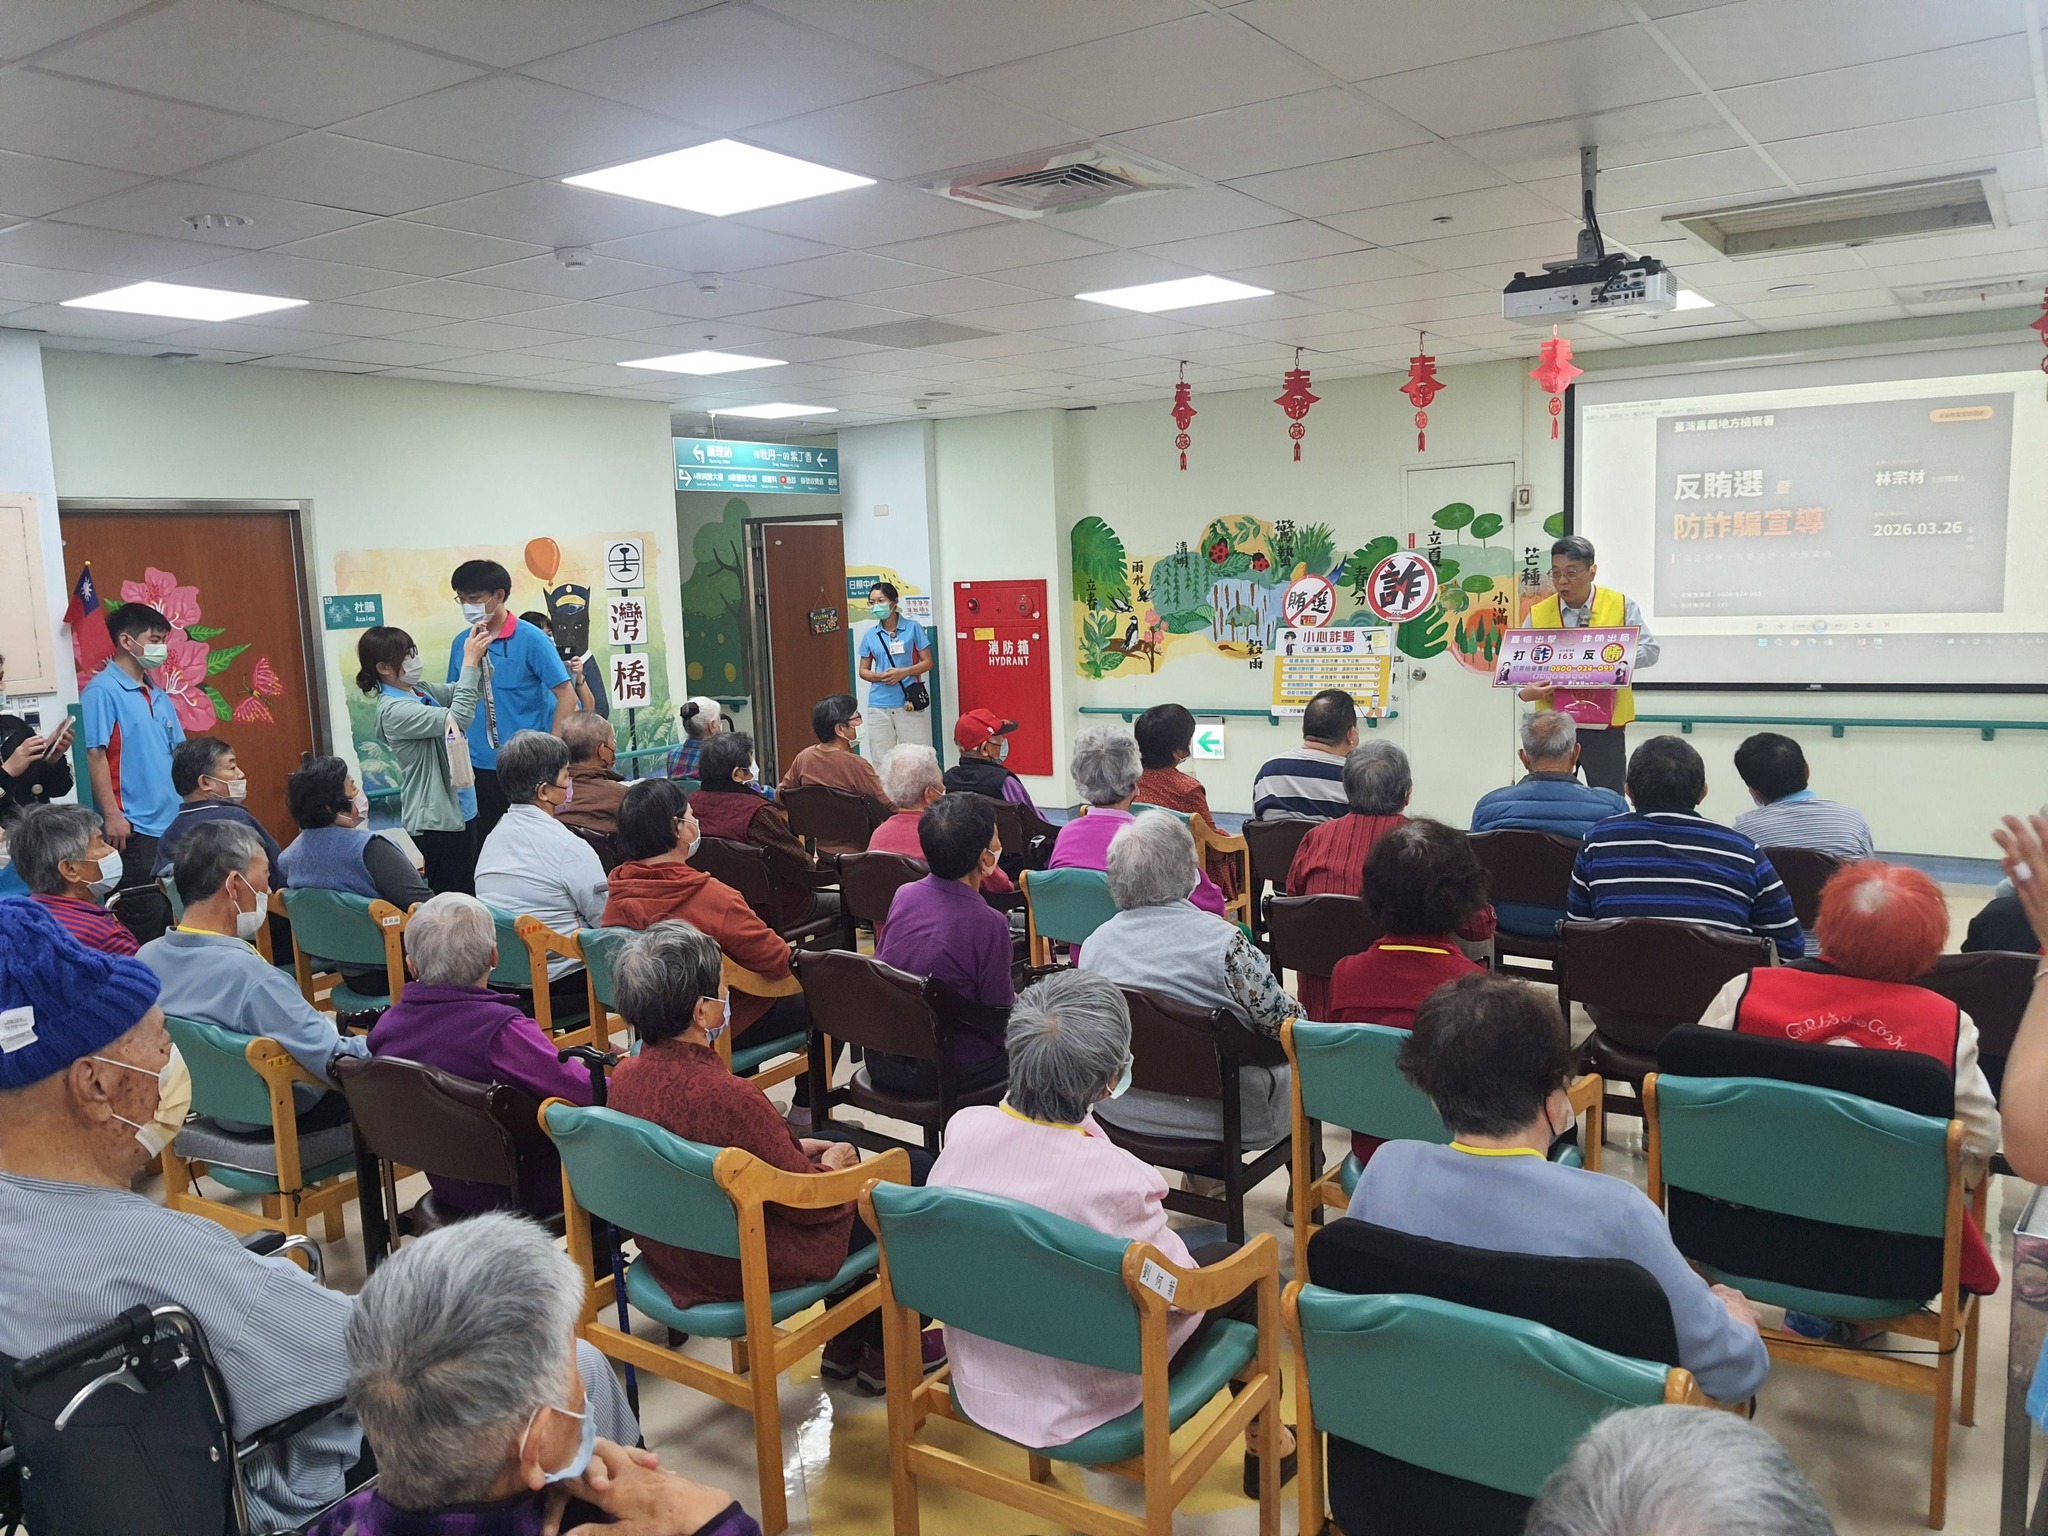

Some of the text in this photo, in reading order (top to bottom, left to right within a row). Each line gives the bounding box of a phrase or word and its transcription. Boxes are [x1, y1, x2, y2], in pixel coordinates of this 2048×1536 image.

[1674, 469, 1763, 501] 反賄選
[1875, 469, 1926, 487] 林宗材
[1673, 507, 1825, 541] 防詐騙宣導
[1873, 521, 1963, 537] 2026.03.26
[1175, 541, 1188, 567] 清明
[1275, 519, 1294, 568] 驚蟄
[1427, 531, 1442, 568] 立夏
[1132, 560, 1144, 585] 雨水
[1521, 547, 1540, 586] 芒種
[1085, 579, 1099, 611] 立春
[1350, 565, 1369, 606] 春分
[1379, 561, 1426, 610] 詐
[324, 597, 333, 605] 19
[1287, 591, 1330, 613] 賄選
[1492, 591, 1509, 625] 小滿
[988, 640, 1029, 655] 消防箱
[1303, 630, 1355, 643] 小心詐騙
[989, 656, 1029, 666] HYDRANT
[1246, 639, 1263, 670] 穀雨
[1550, 664, 1615, 672] 0800-024-099
